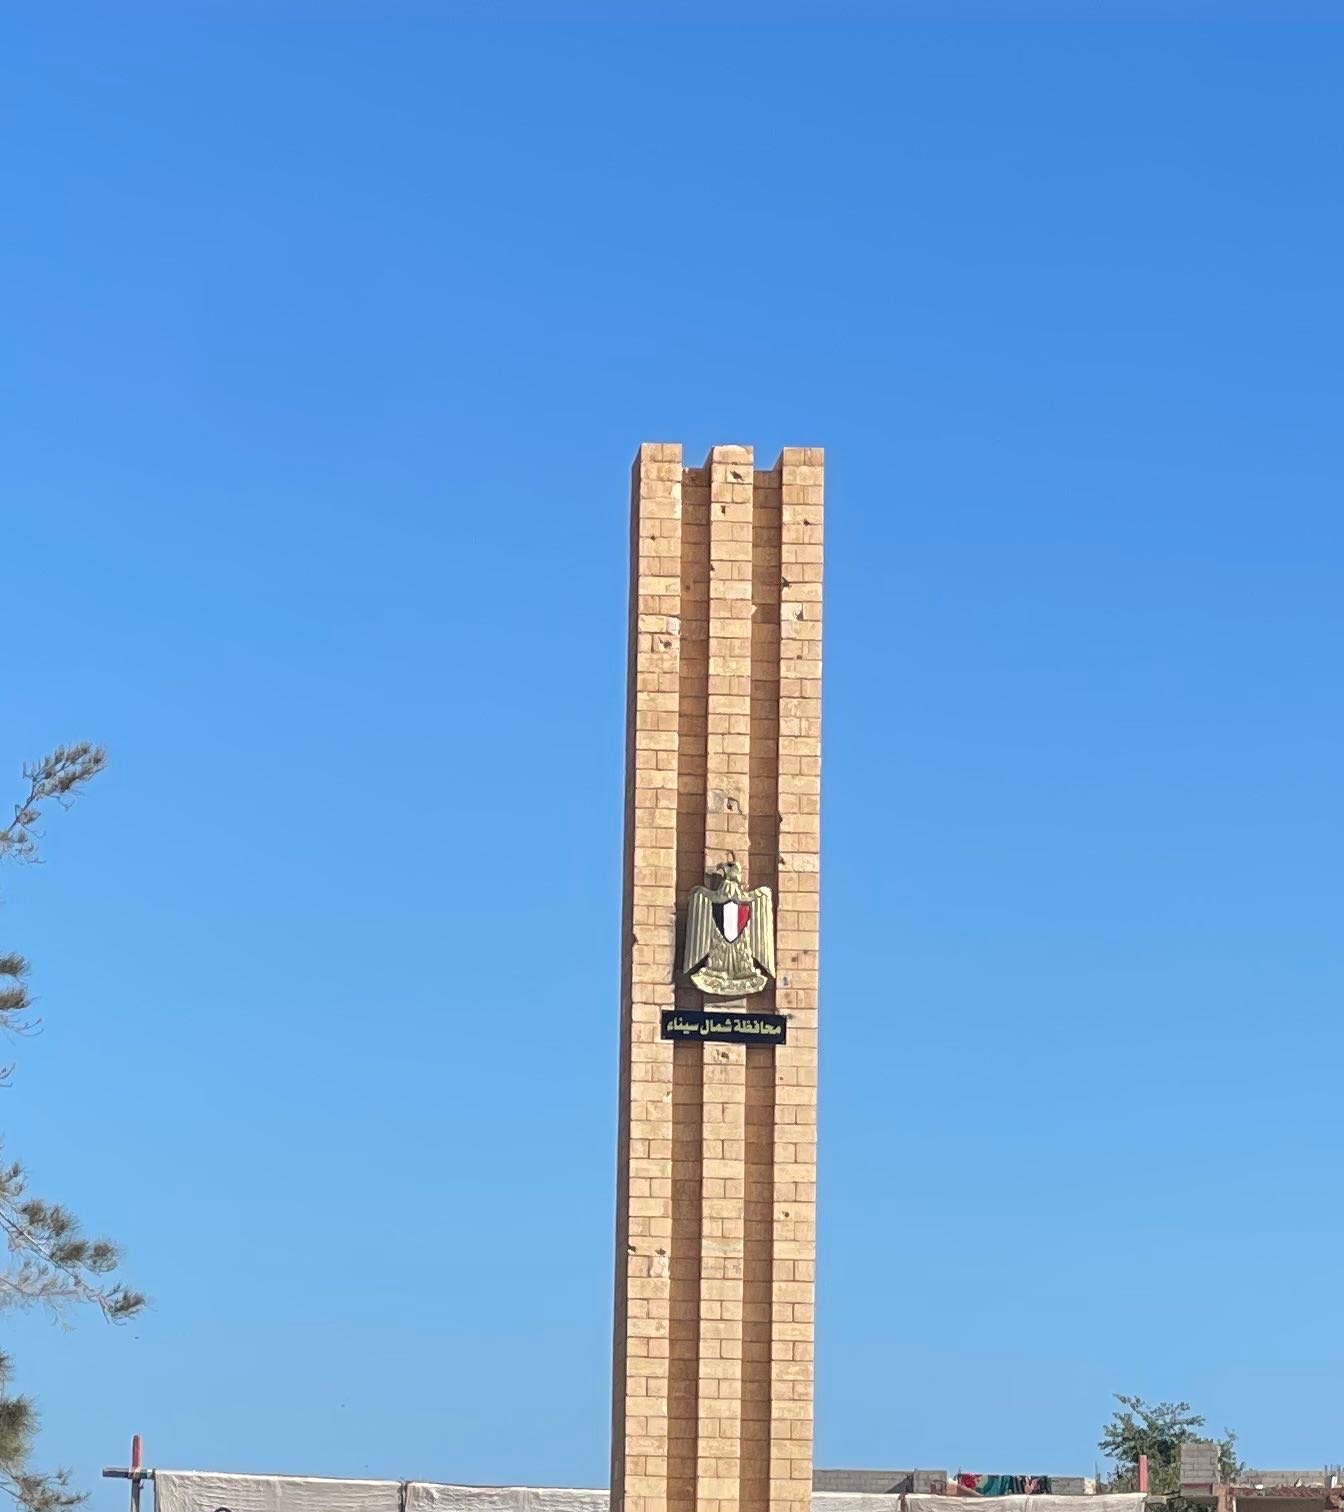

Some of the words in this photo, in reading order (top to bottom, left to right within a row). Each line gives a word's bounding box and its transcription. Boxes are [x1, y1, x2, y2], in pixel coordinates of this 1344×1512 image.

[666, 1016, 699, 1034] سيناء
[699, 1018, 733, 1035] شمال
[733, 1018, 782, 1035] محافظة
